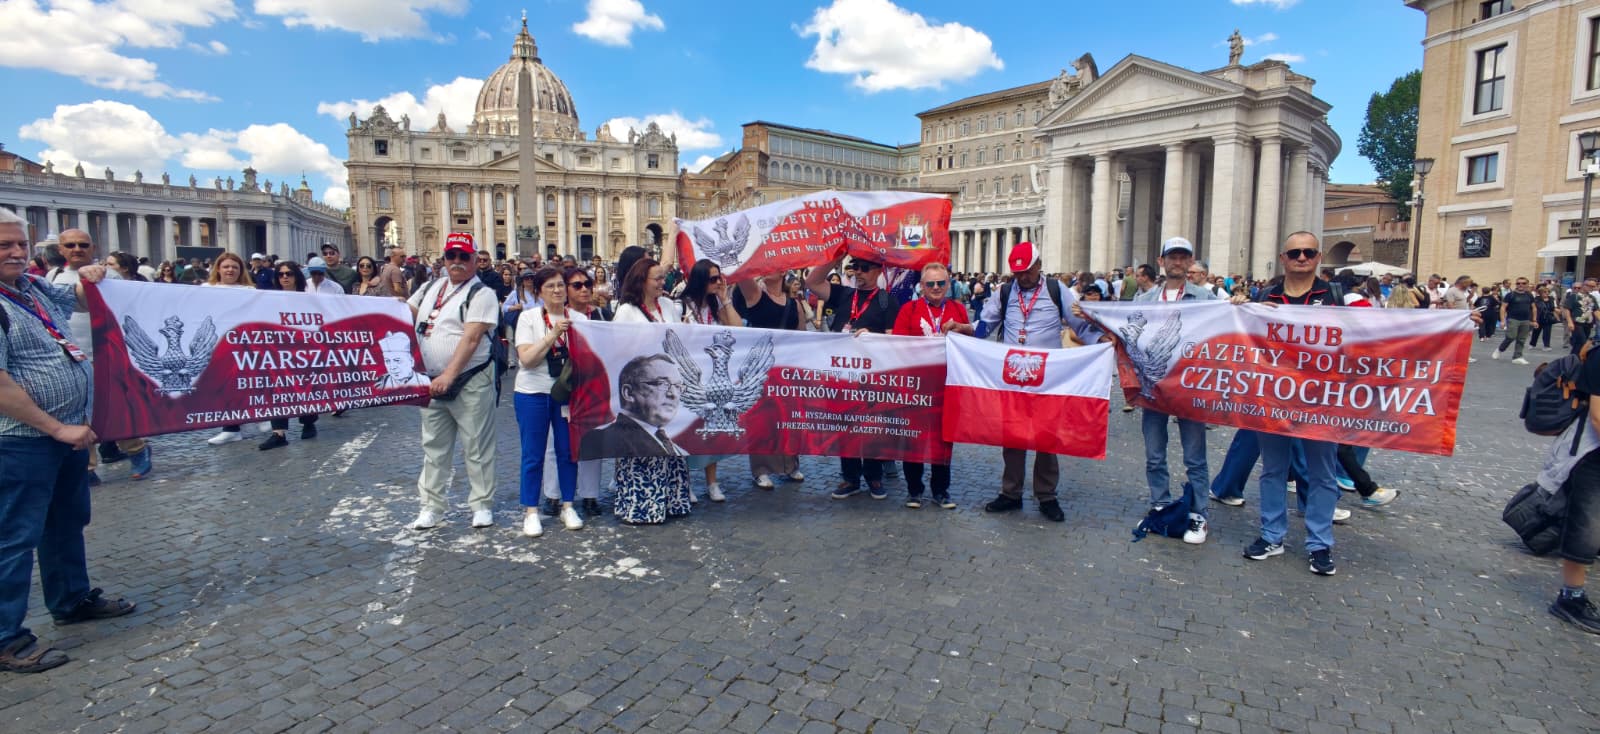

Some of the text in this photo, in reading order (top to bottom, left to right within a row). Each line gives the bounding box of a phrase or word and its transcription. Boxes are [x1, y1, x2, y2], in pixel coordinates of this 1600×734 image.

[757, 208, 886, 228] GAZETY POKIEJ
[447, 236, 470, 244] POLSKA
[761, 229, 809, 244] PERTH
[822, 217, 887, 242] AUSTRIA
[781, 246, 800, 255] RTM
[279, 312, 324, 326] KLUB
[225, 330, 375, 345] GAZETY POLSKIEJ
[1266, 322, 1343, 347] KLUB
[232, 348, 377, 371] WARSZAWA
[830, 355, 872, 369] KLUB
[1181, 341, 1444, 385] GAZETY POLSKIEJ
[237, 370, 379, 390] BIELANY-ŻOLIBORZ
[781, 368, 921, 391] GAZETY POLSKIEJ
[249, 386, 373, 406] IM. PRYMASA POLSKI
[767, 384, 933, 407] PIOTRKÓW TRYBUNALSKI
[1179, 365, 1436, 417] CZĘSTOCHOWA
[185, 409, 251, 424] STEFANA
[254, 401, 332, 419] KARDYNAŁA
[791, 411, 910, 426] IM. RYSZARDA KAPUŚCIŃSKIEGO
[1192, 397, 1411, 435] IM. JANUSZA KOCHANOWSKIEGO
[782, 422, 815, 431] PREZESA
[817, 422, 848, 432] KLUBÓW
